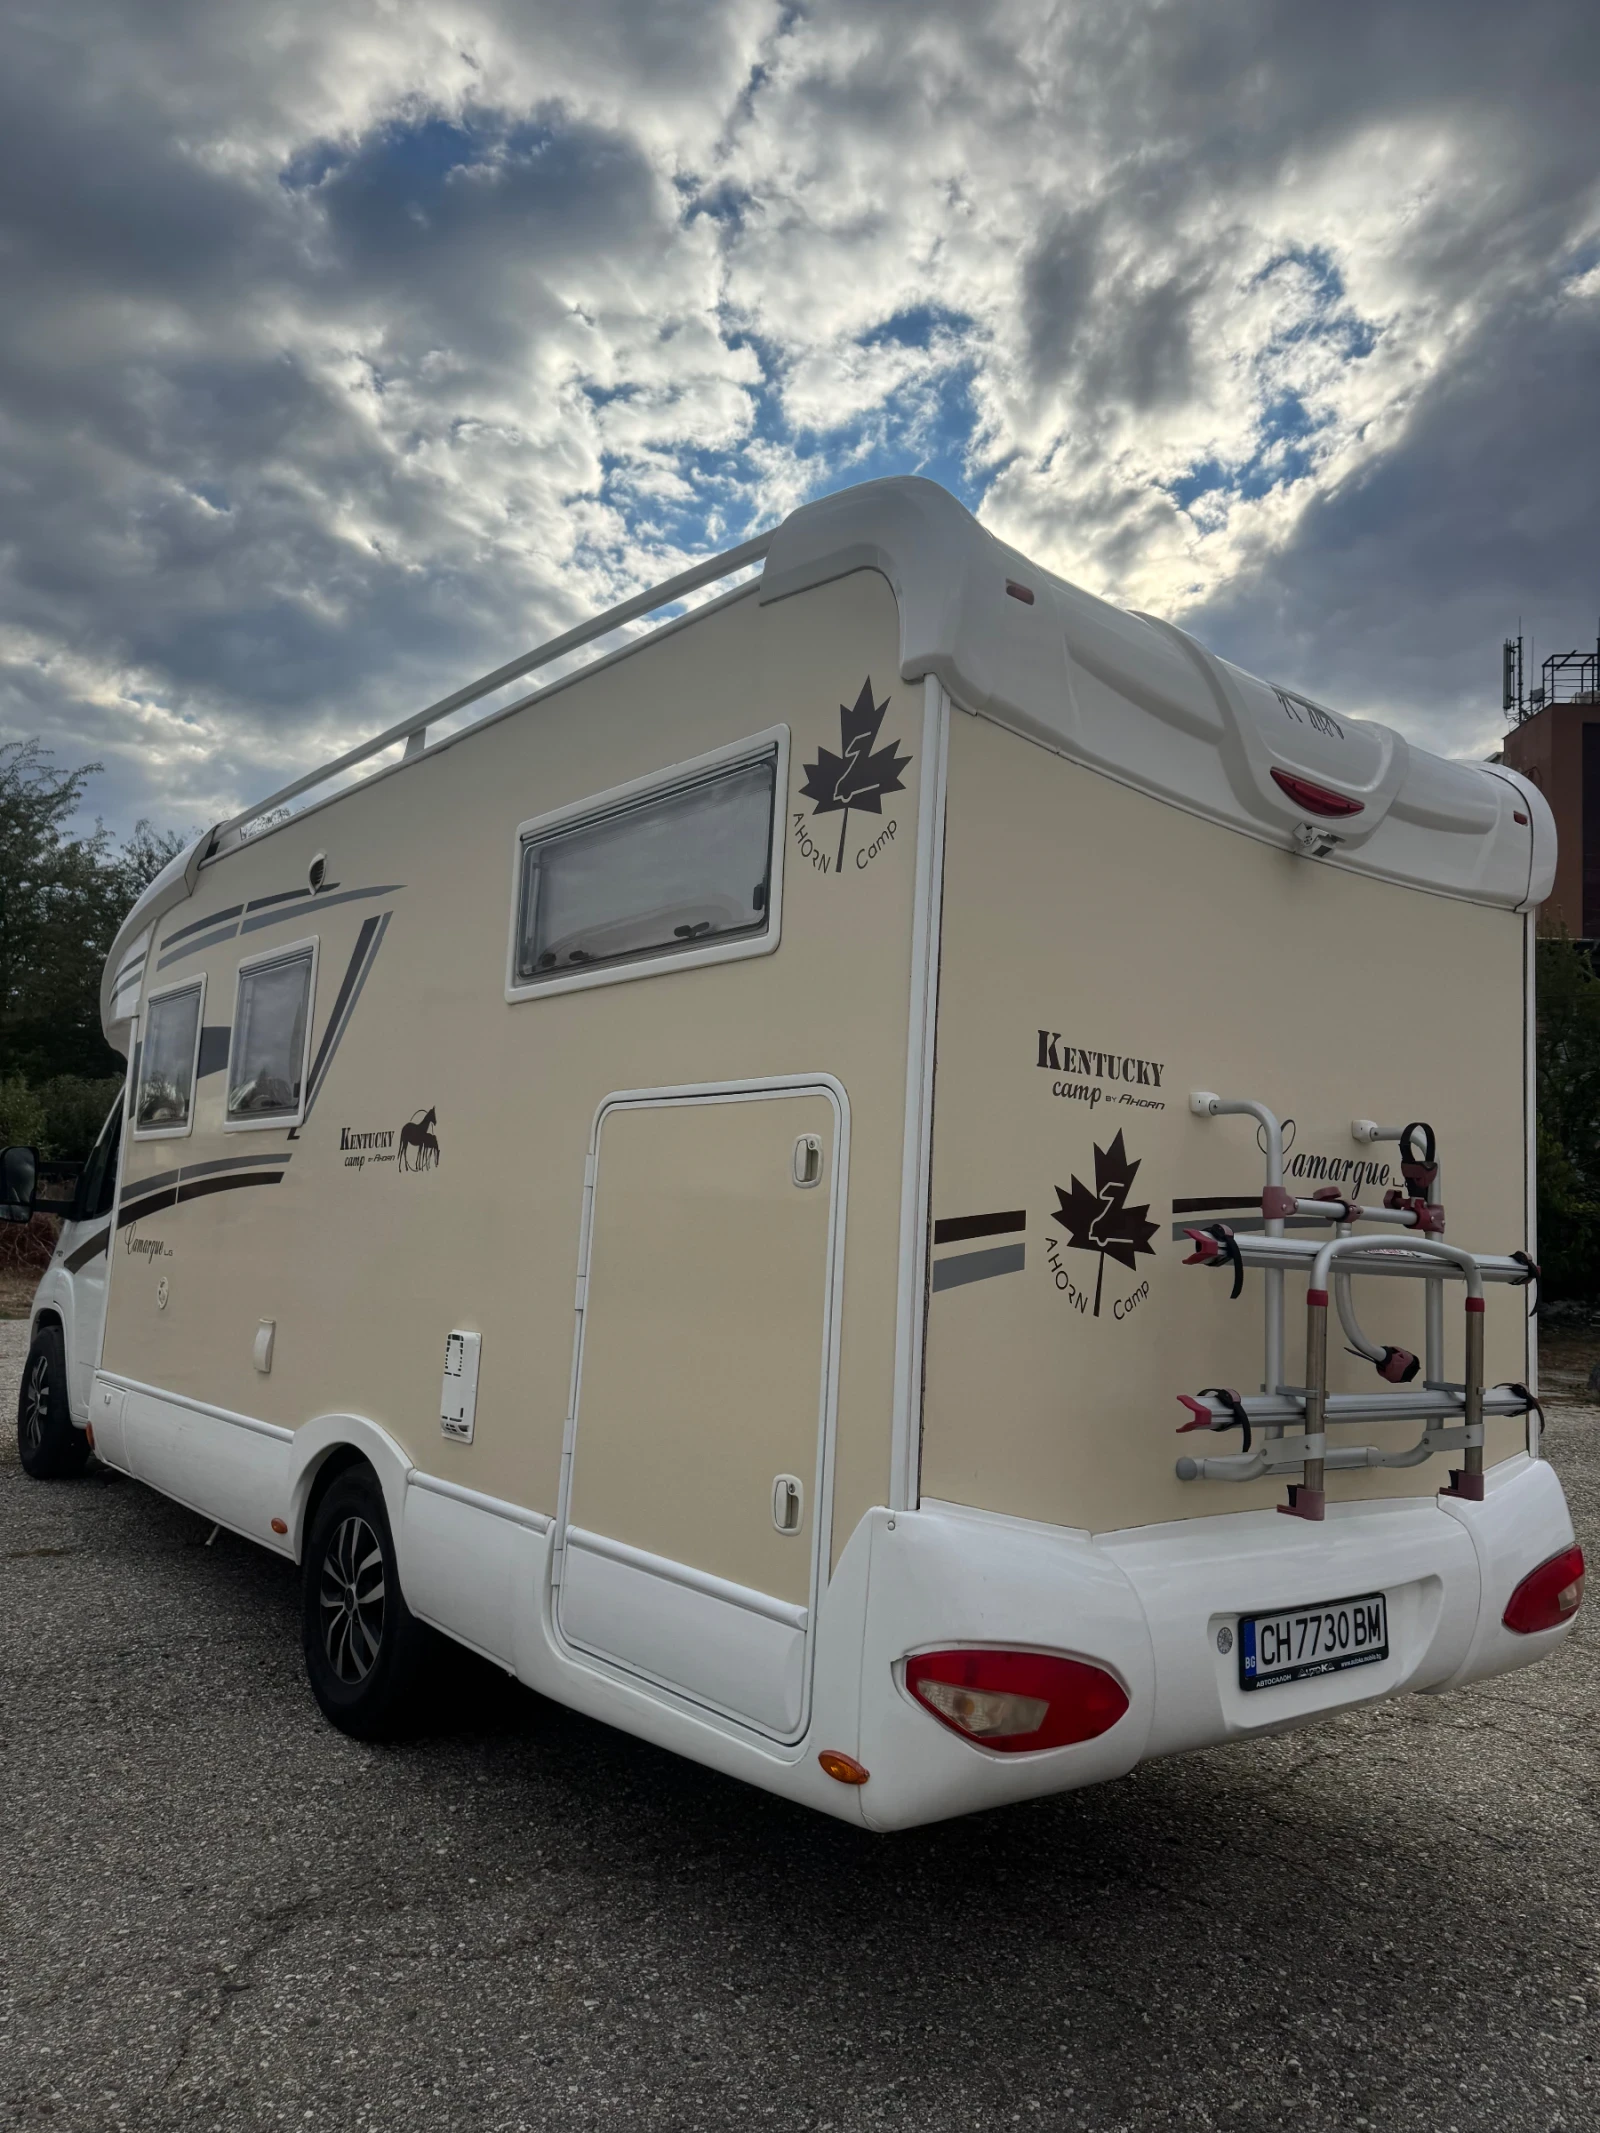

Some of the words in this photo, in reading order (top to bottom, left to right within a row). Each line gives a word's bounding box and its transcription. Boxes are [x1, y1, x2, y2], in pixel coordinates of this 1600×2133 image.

[793, 813, 831, 873] AHORN
[856, 820, 897, 869] Camp
[1053, 1081, 1102, 1109] camp
[345, 1156, 365, 1172] camp
[125, 1221, 164, 1264] Camargue
[1045, 1238, 1088, 1314] AHORN
[1113, 1281, 1149, 1320] Camp
[1245, 1656, 1256, 1669] BG
